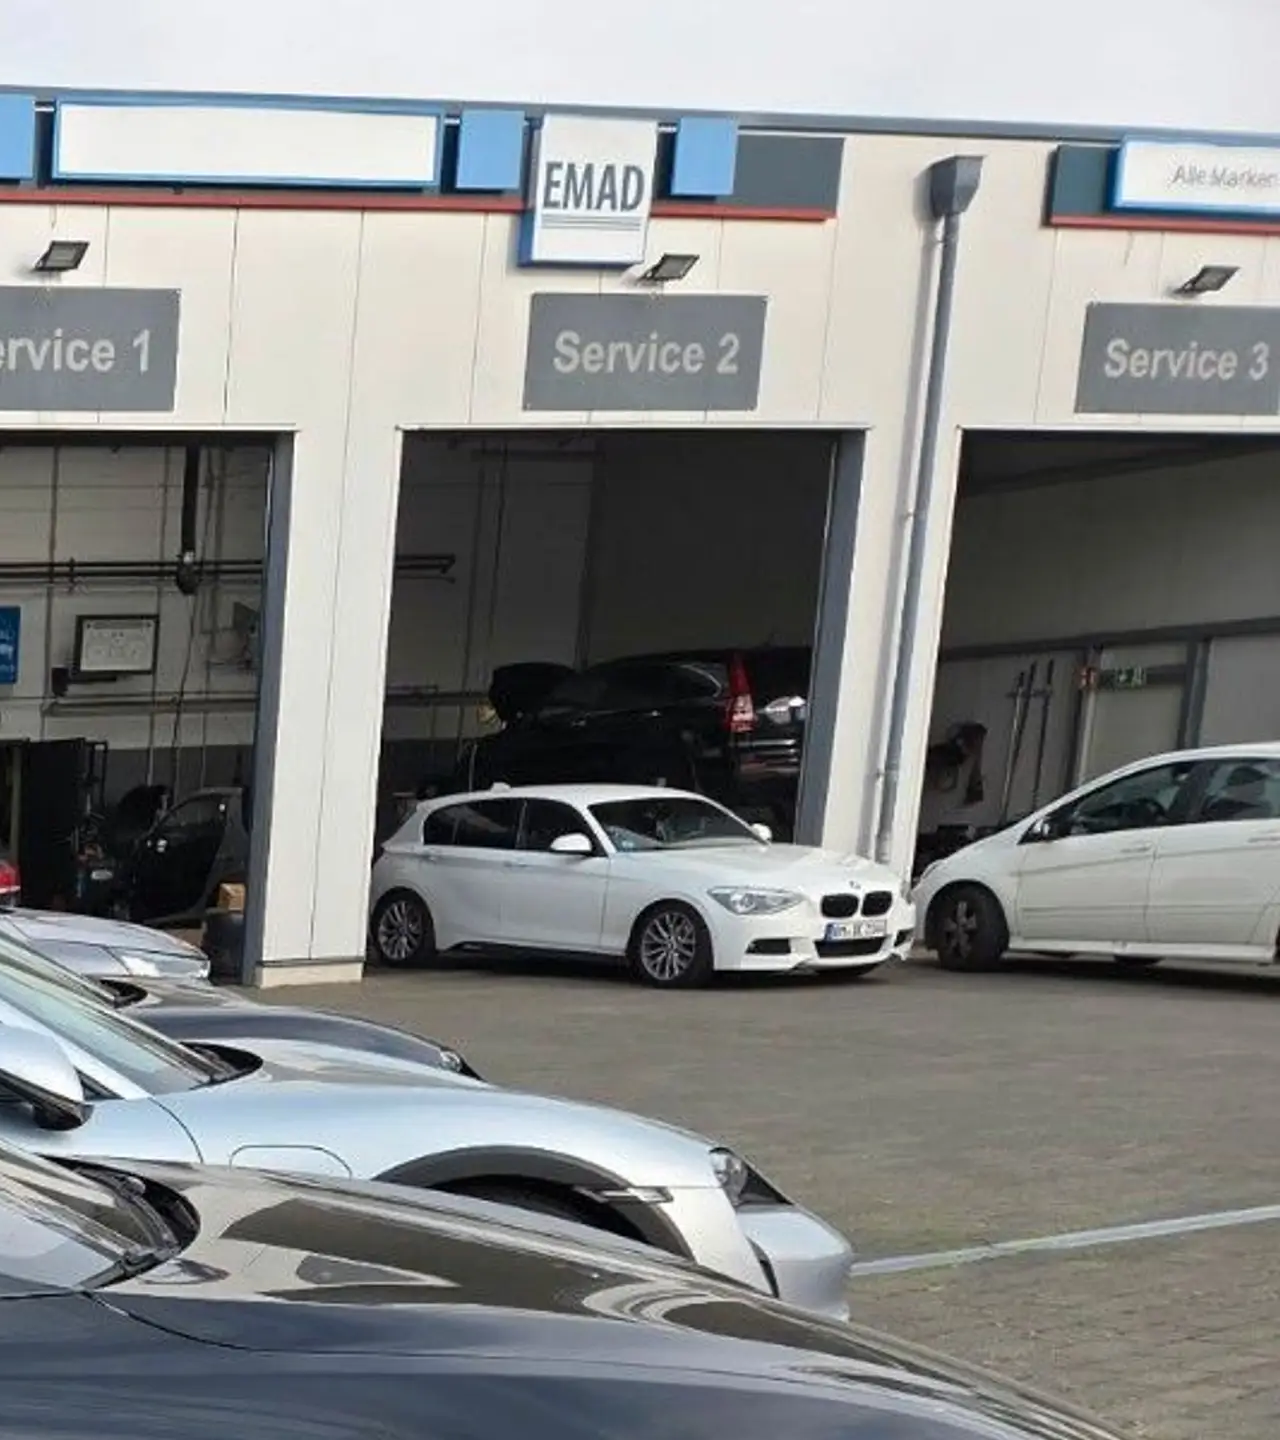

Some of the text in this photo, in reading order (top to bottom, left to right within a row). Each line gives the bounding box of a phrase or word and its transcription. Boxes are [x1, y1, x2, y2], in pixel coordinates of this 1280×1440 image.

[542, 162, 645, 212] EMAD
[132, 329, 151, 373] 1
[553, 330, 740, 375] Service 2
[1104, 338, 1270, 382] Service 3
